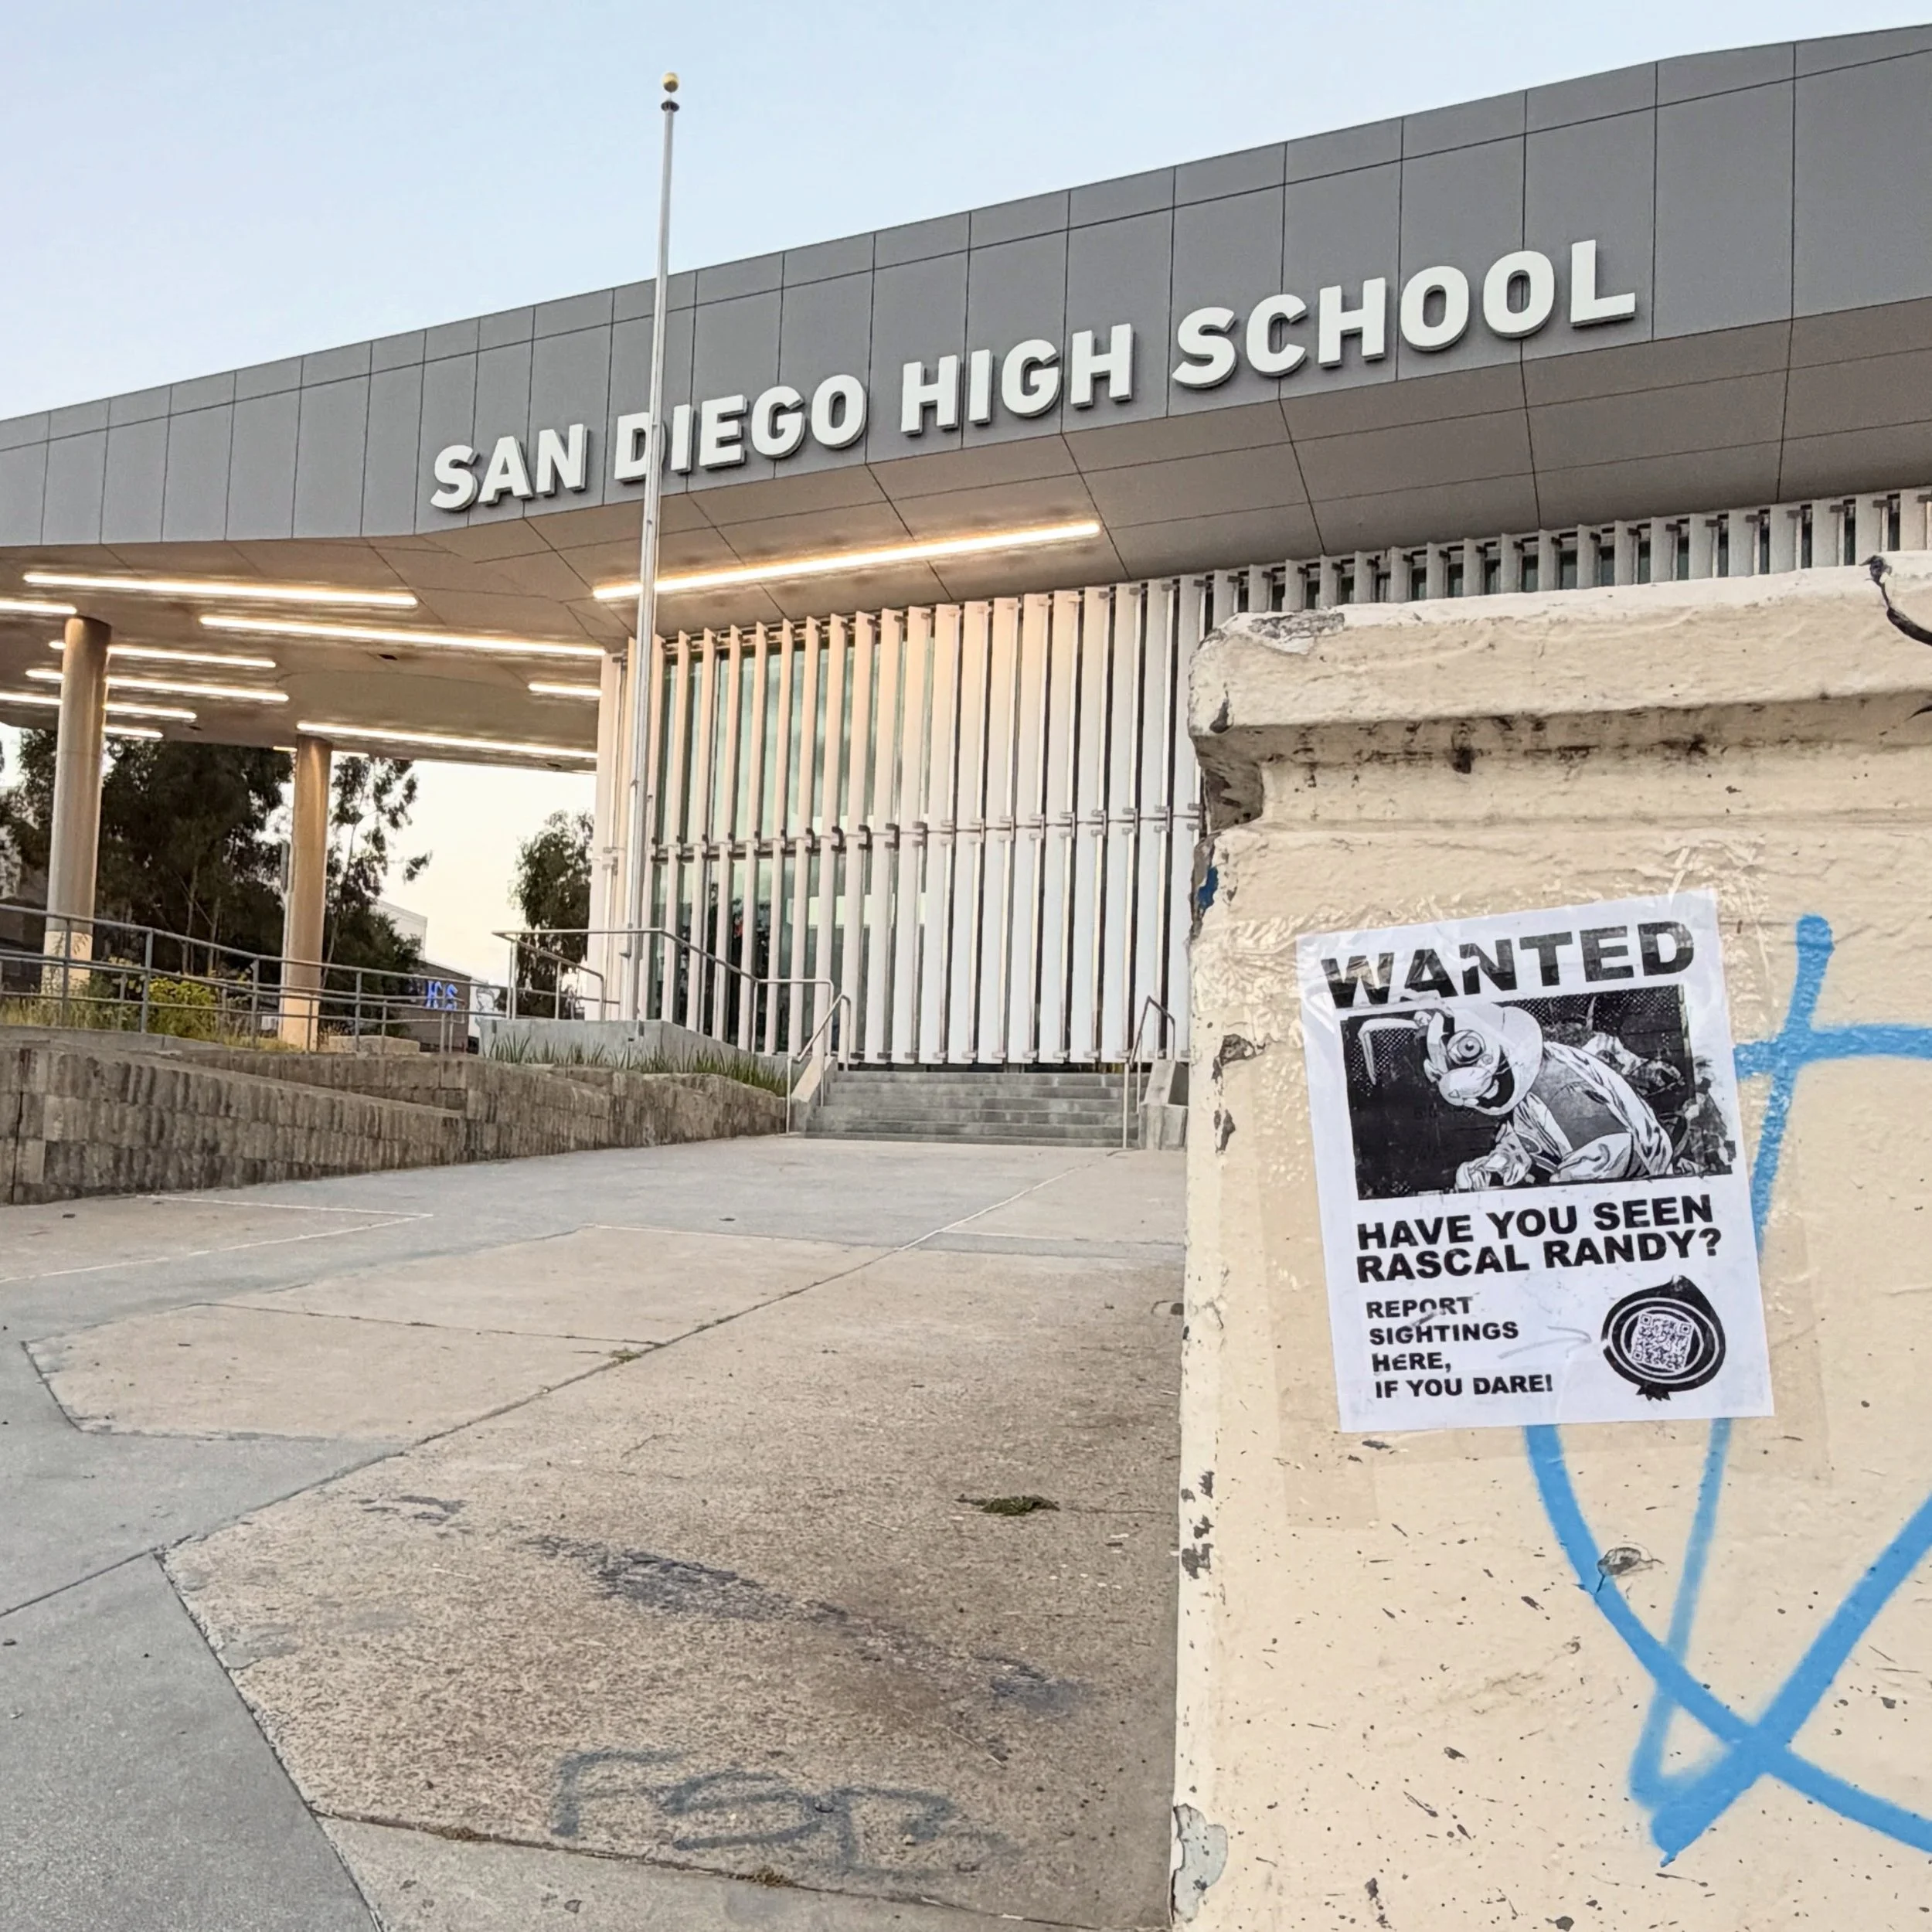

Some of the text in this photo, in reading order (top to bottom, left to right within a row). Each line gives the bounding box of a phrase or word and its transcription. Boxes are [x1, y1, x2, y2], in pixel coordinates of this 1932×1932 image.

[430, 240, 1636, 511] SAN DIEGO HIGH SCHOOL
[1321, 921, 1694, 1009] WANTED
[1357, 1194, 1713, 1250] HAVE YOU SEEN
[1356, 1227, 1722, 1284] RASCAL RANDY?
[1366, 1296, 1473, 1319] REPORT
[1369, 1321, 1519, 1345] SIGHTINGS
[1372, 1352, 1451, 1372] HERE,
[1376, 1374, 1553, 1399] IF YOU DARE!
